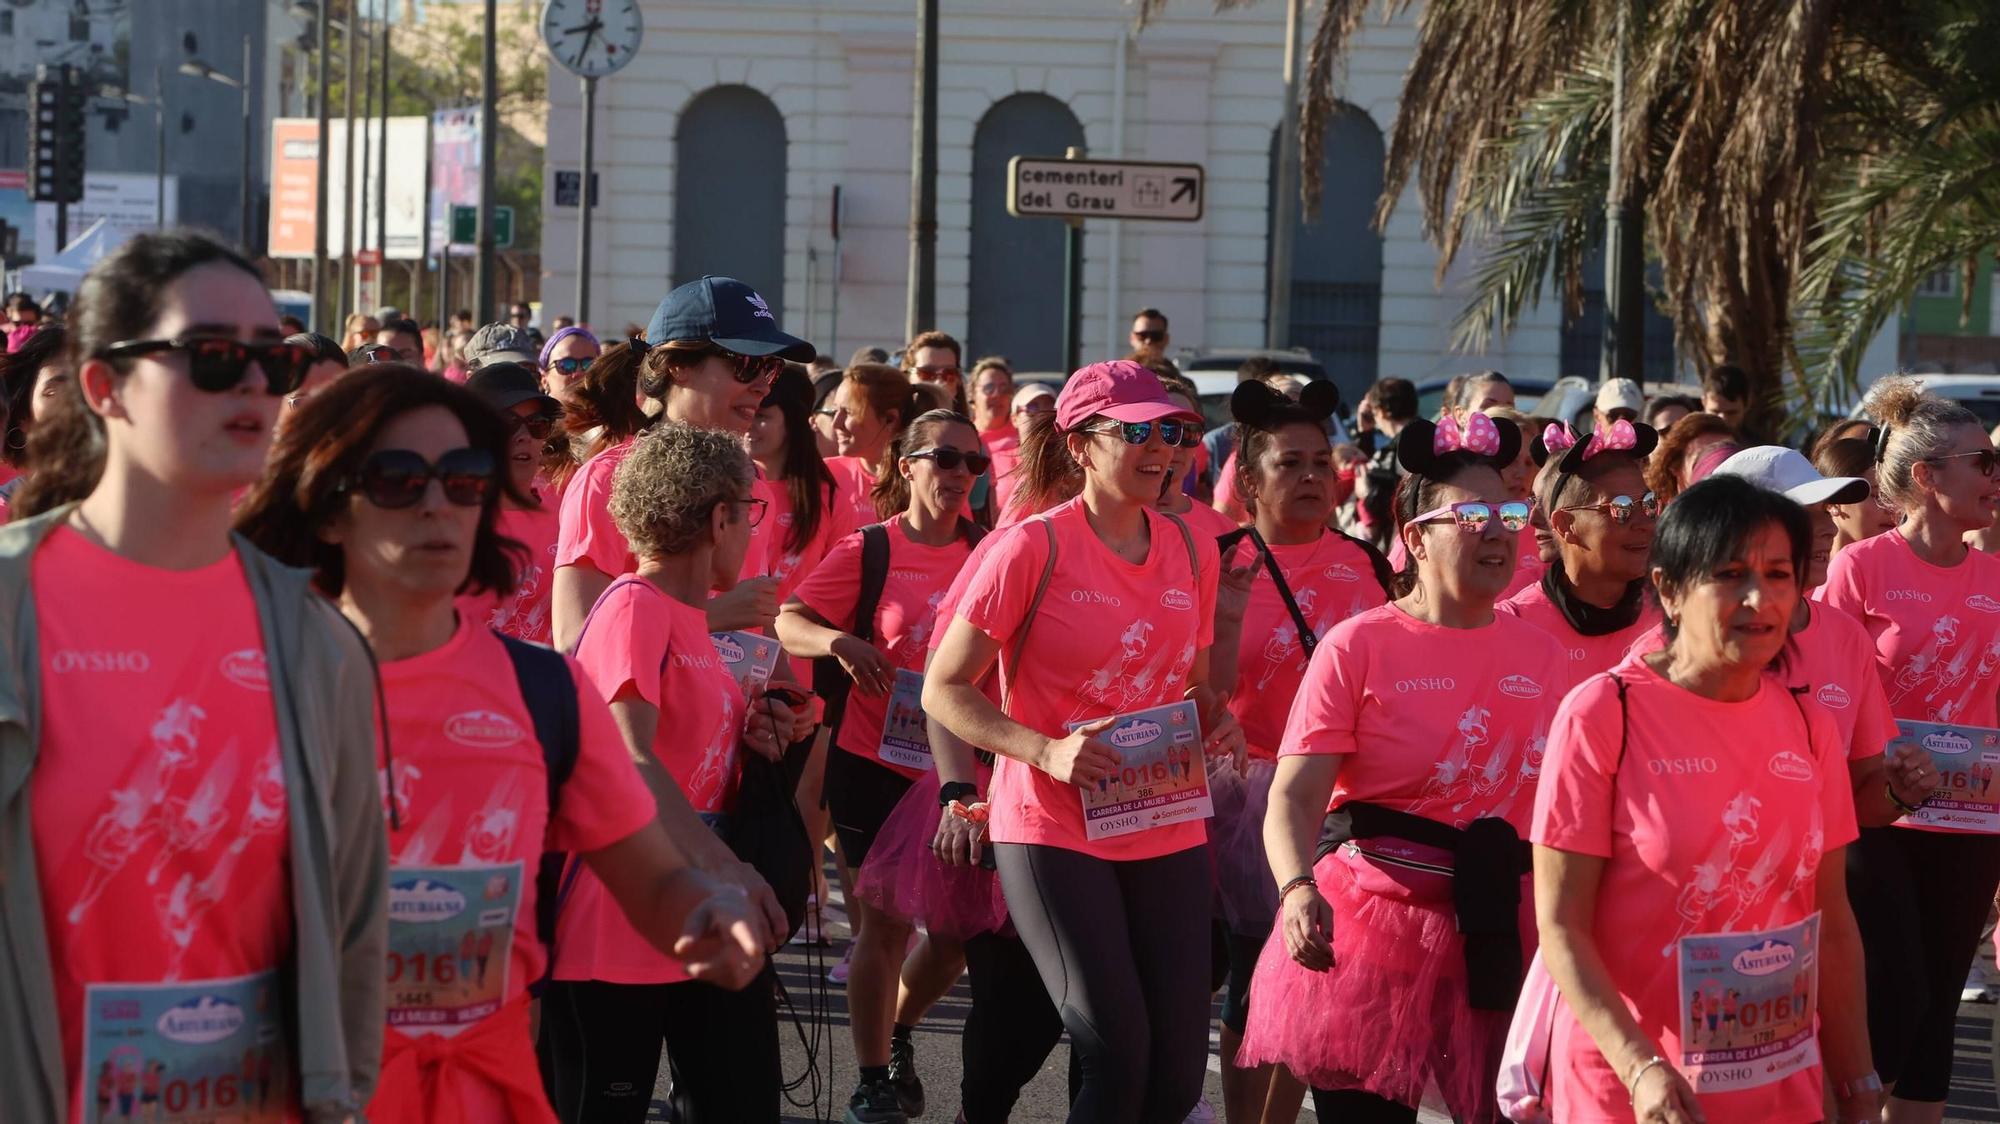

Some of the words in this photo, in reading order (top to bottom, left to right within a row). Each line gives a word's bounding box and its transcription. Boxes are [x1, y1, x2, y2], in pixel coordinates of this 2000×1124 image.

[1021, 168, 1123, 186] cementeri
[1021, 192, 1052, 208] del
[1066, 193, 1115, 210] Grau
[1071, 589, 1120, 607] OYSHO
[1885, 589, 1932, 603] OYSHO
[51, 650, 150, 674] OYSHO
[1395, 677, 1455, 693] OYSHO
[1115, 727, 1160, 744] ASTURIANA
[1926, 737, 1969, 750] ASTURIANA
[890, 750, 923, 764] OYSHO
[1122, 761, 1168, 786] 016
[1648, 757, 1718, 776] OYSHO
[1940, 769, 1967, 788] 16
[1137, 787, 1154, 799] 386
[1091, 805, 1122, 818] CARRERA
[1123, 803, 1133, 811] DE
[1133, 800, 1143, 809] LA
[1143, 797, 1166, 807] MUJER
[1170, 788, 1200, 801] VALENCIA
[1964, 802, 1993, 811] VALENCIA
[1161, 805, 1198, 819] Santander
[1100, 815, 1138, 832] OYSHO
[1738, 952, 1793, 971] ASTURIANA
[1740, 995, 1791, 1028] 016
[1691, 1050, 1734, 1064] CARRERA
[1735, 1049, 1749, 1061] DE
[1701, 1068, 1753, 1084] OYSHO
[164, 1073, 239, 1114] 016
